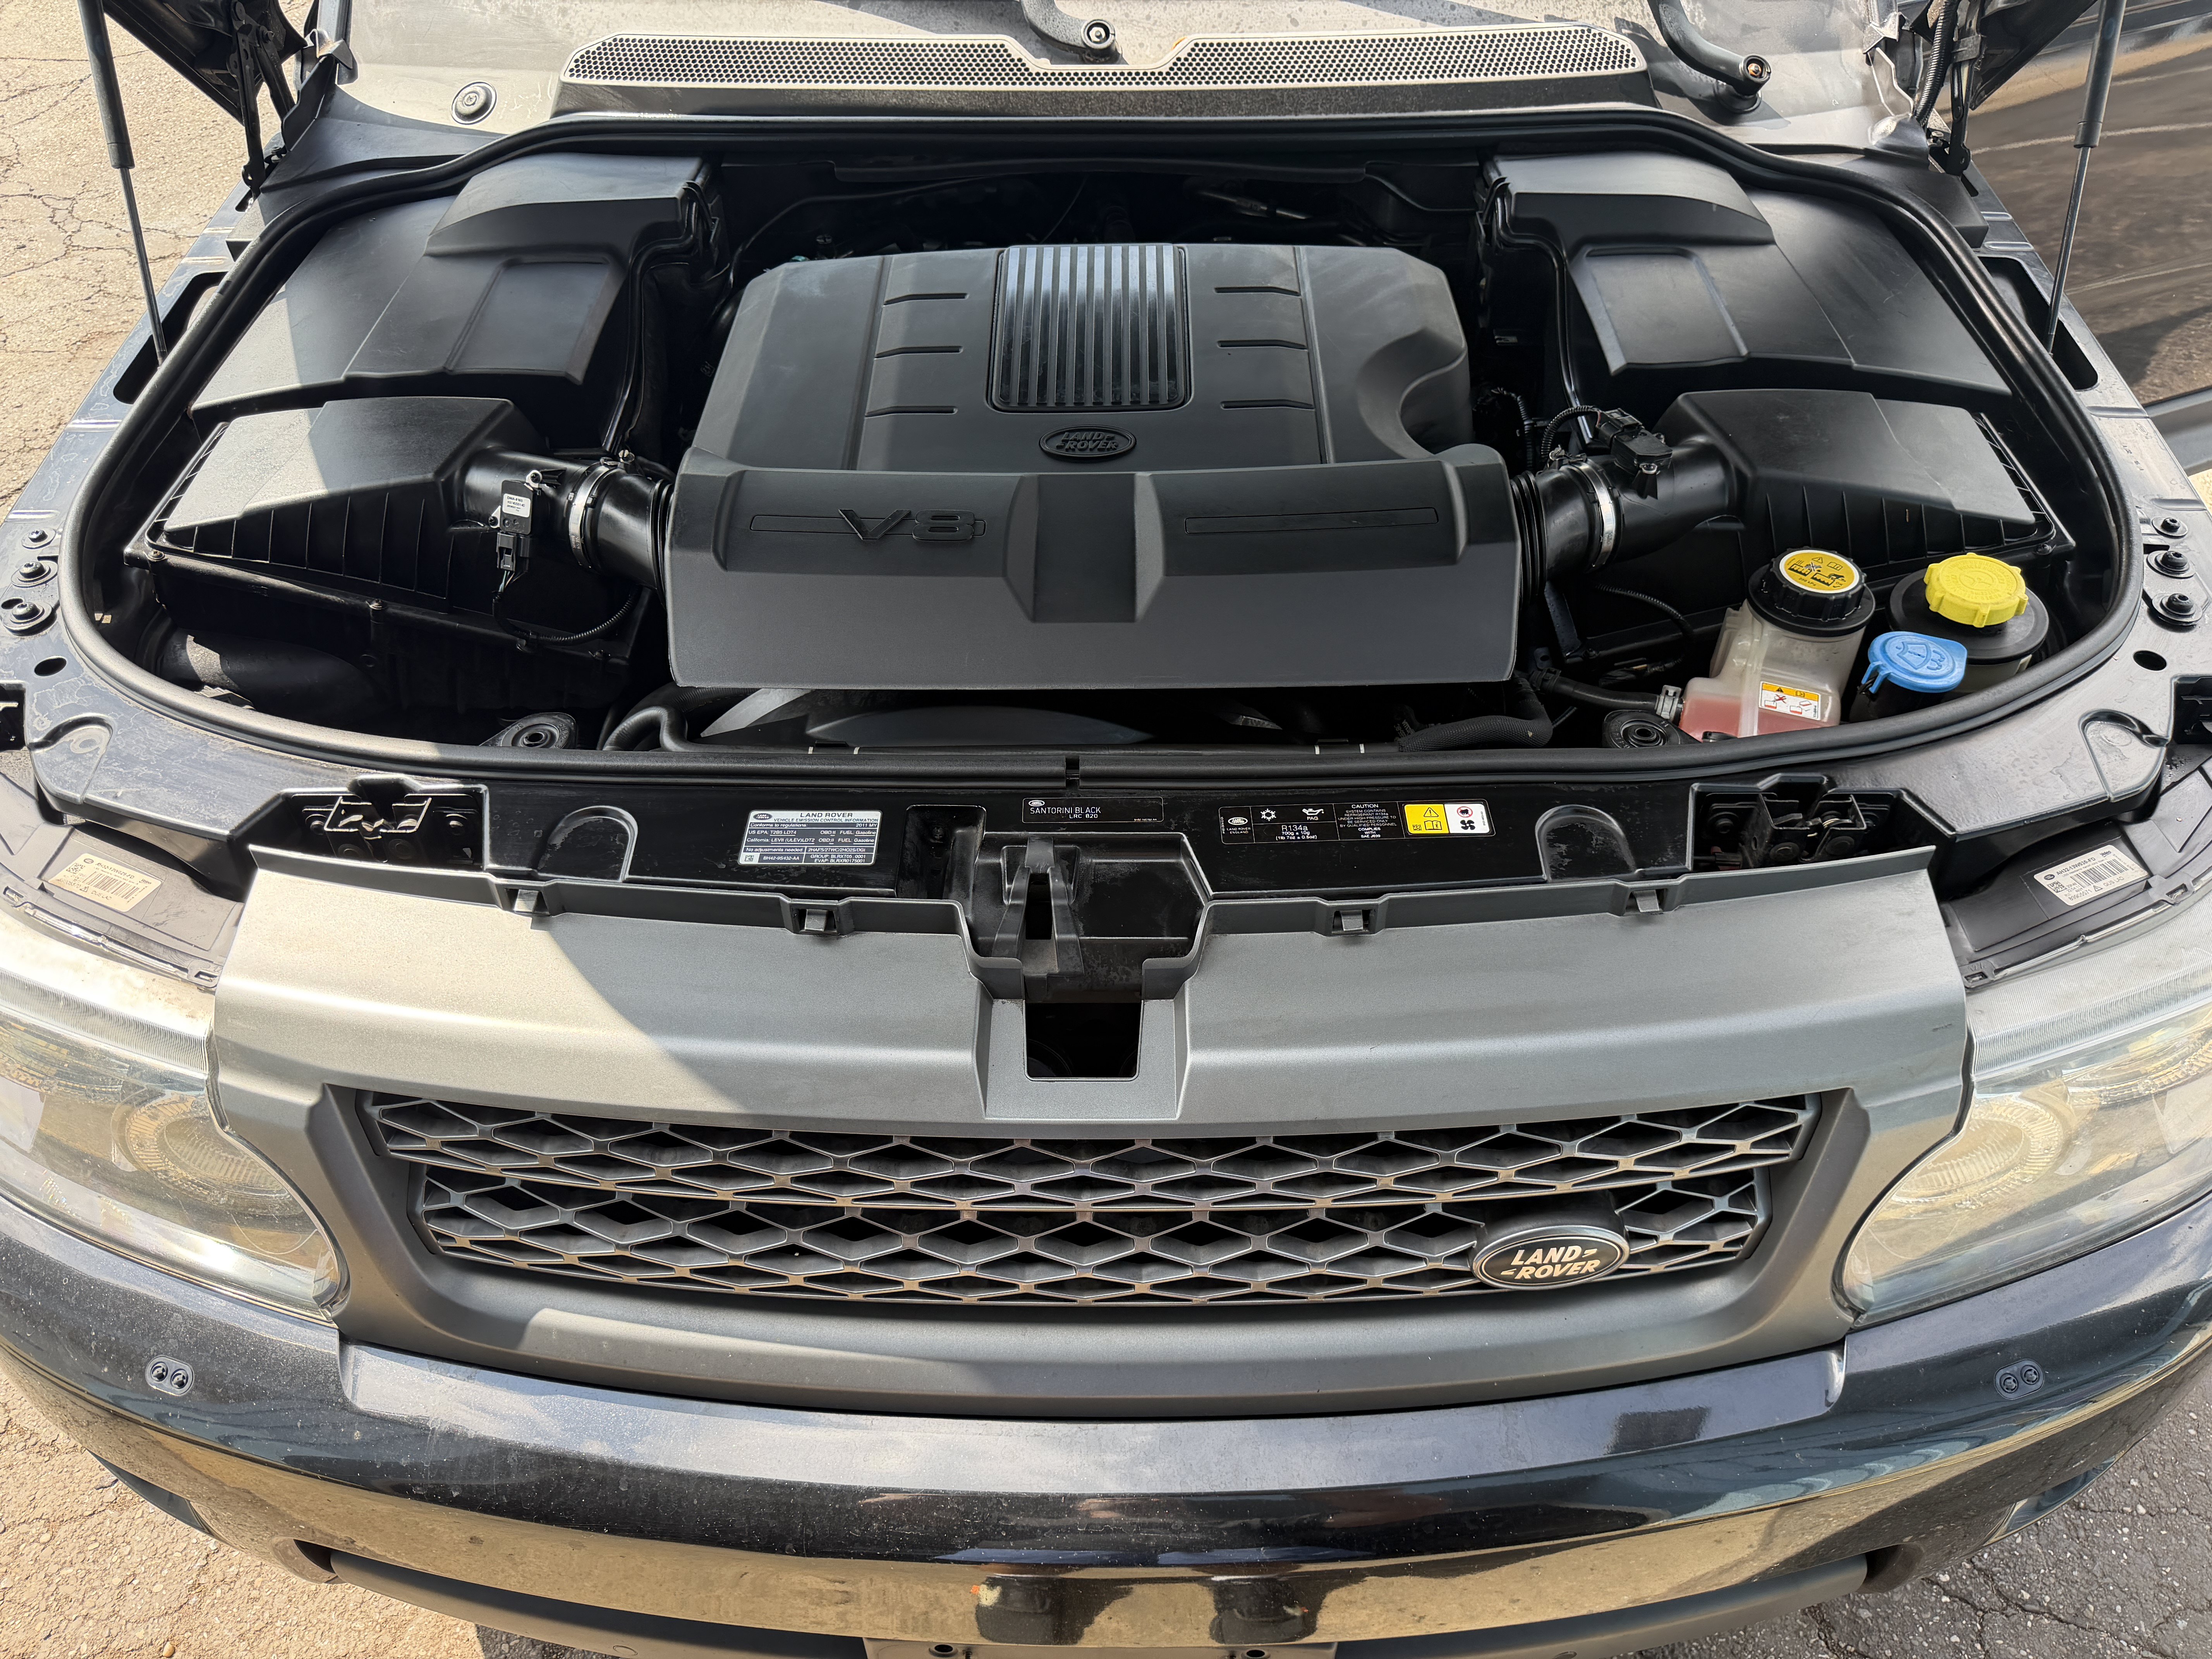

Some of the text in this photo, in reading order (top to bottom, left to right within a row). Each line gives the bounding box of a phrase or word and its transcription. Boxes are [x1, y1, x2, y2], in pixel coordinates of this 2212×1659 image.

[1061, 432, 1104, 442] LAND
[1065, 440, 1119, 451] ROVER
[838, 508, 975, 541] V8
[1511, 1245, 1582, 1265] LAND
[1514, 1260, 1601, 1279] ROVER
